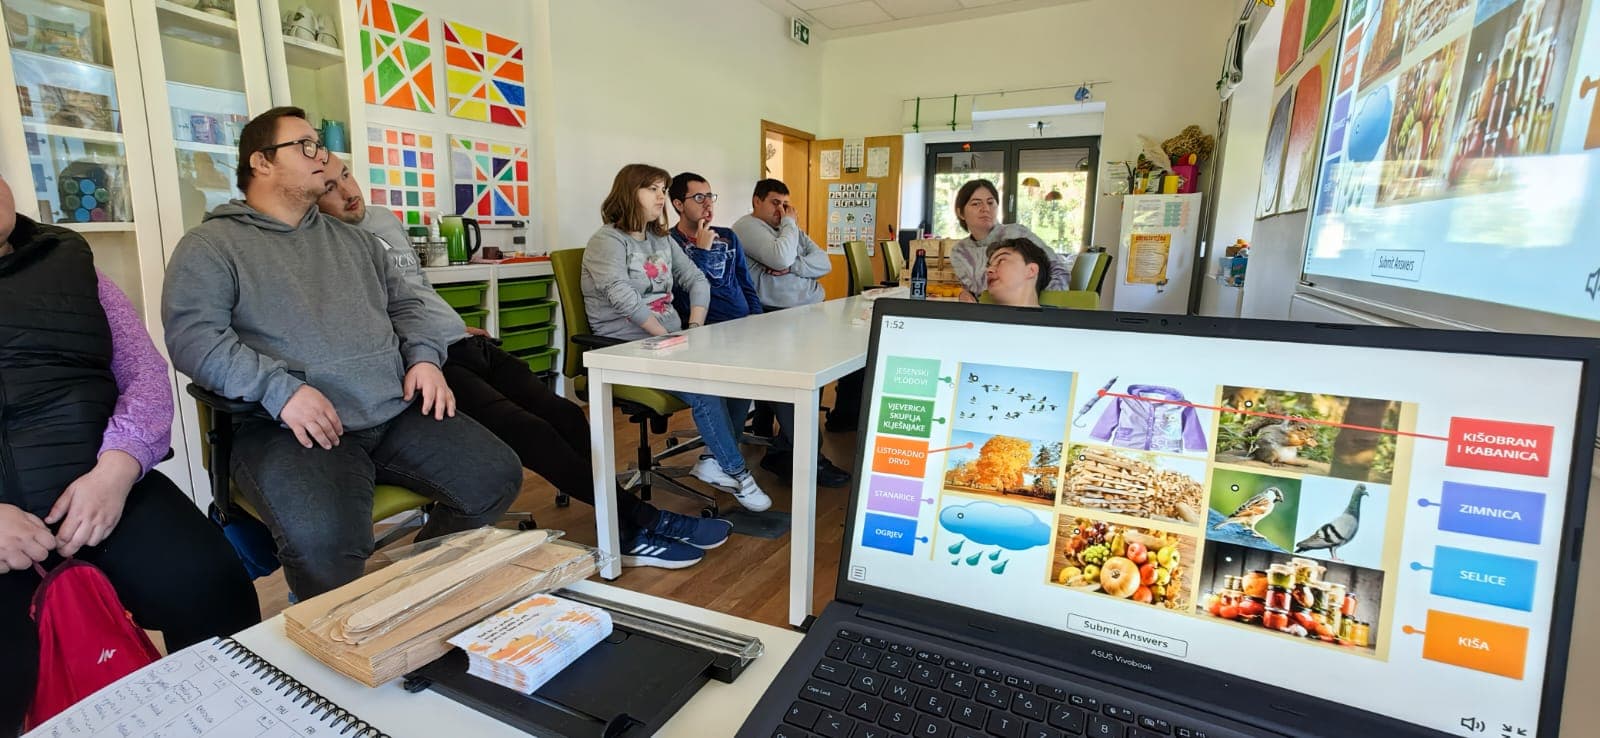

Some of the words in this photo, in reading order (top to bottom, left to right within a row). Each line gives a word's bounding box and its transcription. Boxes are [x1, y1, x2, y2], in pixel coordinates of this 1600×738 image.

[1378, 255, 1394, 269] Submit
[1394, 257, 1415, 271] Answers
[885, 320, 904, 329] 1:52
[896, 367, 929, 377] JESENSKI
[894, 376, 928, 385] PLODOVI
[888, 402, 926, 413] VJEVERICA
[889, 412, 921, 422] SKUPLJA
[883, 420, 926, 432] KLJEŠNJAKE
[1463, 431, 1537, 448] KIŠOBRAN
[876, 446, 925, 459] LISTOPADNO
[1457, 445, 1461, 453] I
[1465, 445, 1540, 462] KABANICA
[888, 457, 910, 466] DRVO
[874, 490, 915, 502] STANARICE
[1459, 504, 1522, 521] ZIMNICA
[875, 528, 904, 539] OGRJEV
[1460, 570, 1507, 586] SELICE
[1083, 620, 1120, 637] Submit
[1122, 630, 1169, 648] Answers
[1458, 636, 1490, 651] KIŠA
[1091, 649, 1113, 661] ASUS
[1115, 655, 1153, 672] Vivobook
[921, 670, 929, 678] 3
[862, 676, 873, 686] Q
[894, 685, 906, 695] W
[989, 689, 998, 698] 5
[929, 696, 937, 706] E
[858, 702, 867, 711] A
[893, 712, 901, 722] S
[963, 707, 972, 717] R
[1061, 711, 1070, 719] 7
[927, 723, 937, 734] D
[1002, 720, 1008, 729] T
[1101, 724, 1109, 734] 8
